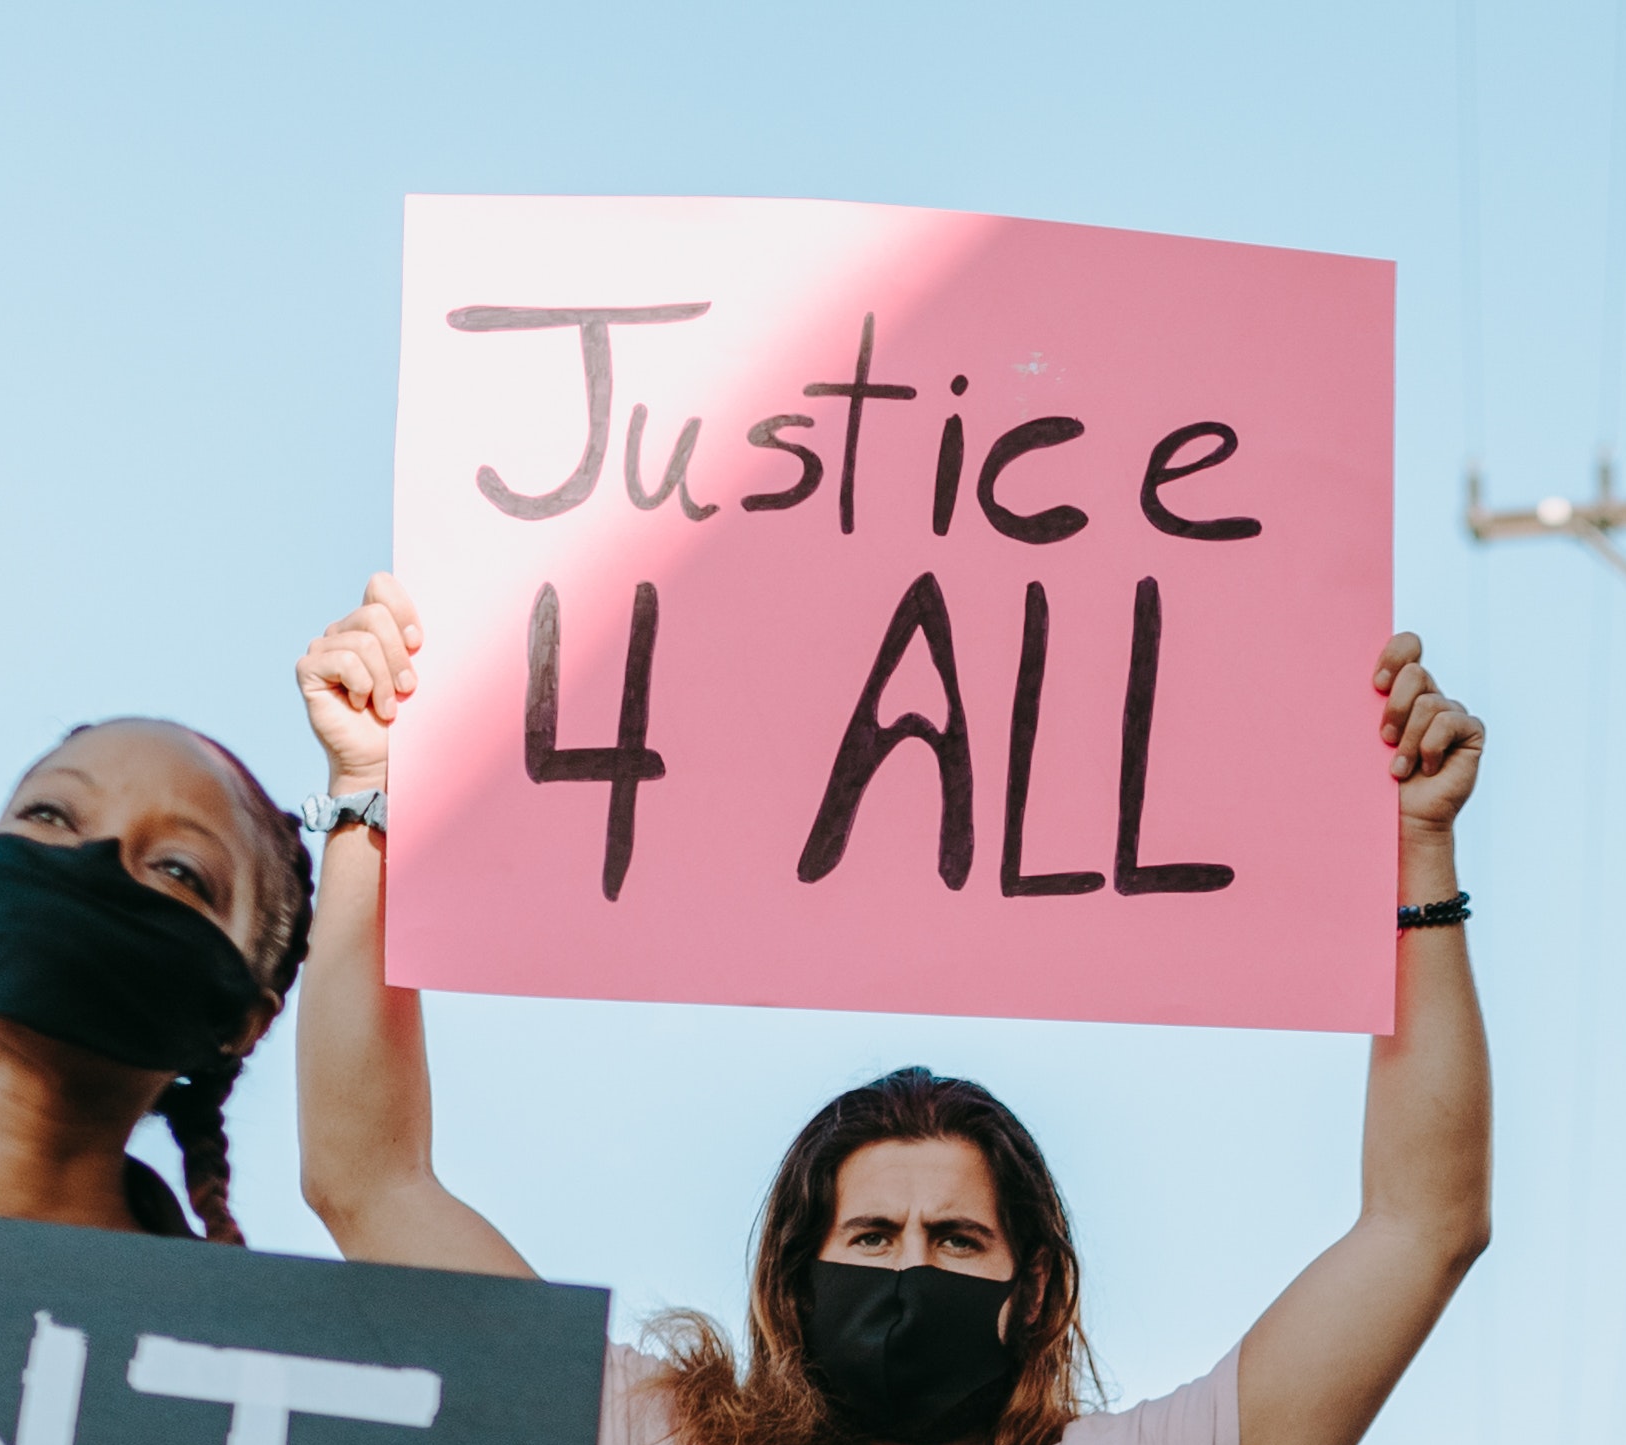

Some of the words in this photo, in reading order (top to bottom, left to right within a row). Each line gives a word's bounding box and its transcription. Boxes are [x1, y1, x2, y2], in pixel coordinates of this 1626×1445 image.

[446, 301, 1262, 546] Justice
[525, 580, 666, 903] 4
[797, 571, 1236, 898] ALL
